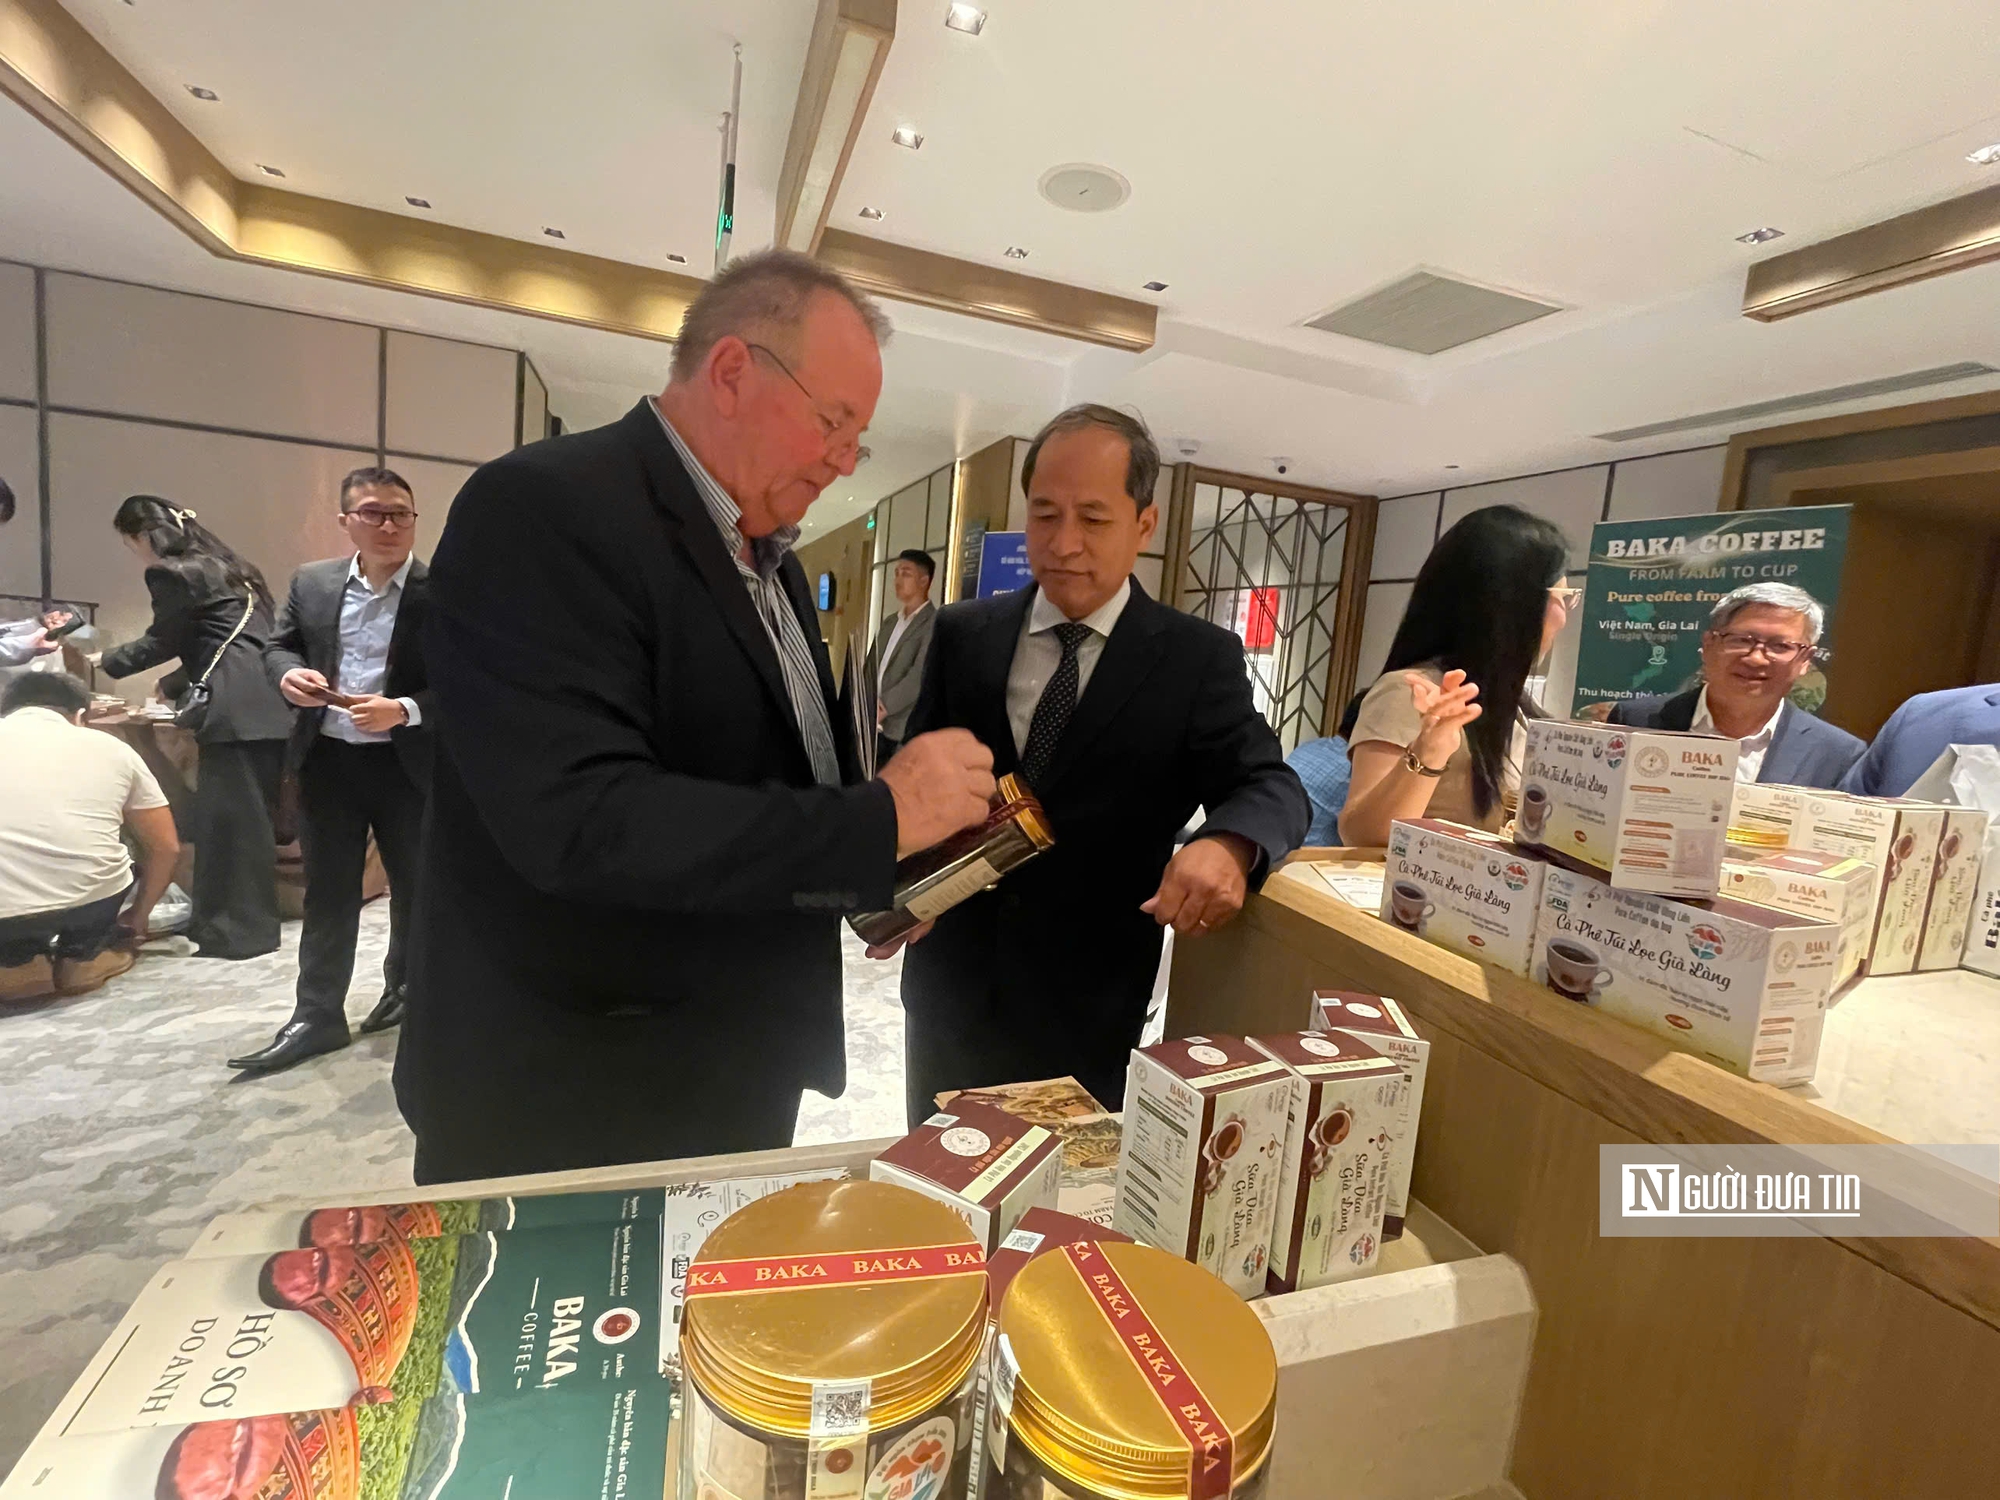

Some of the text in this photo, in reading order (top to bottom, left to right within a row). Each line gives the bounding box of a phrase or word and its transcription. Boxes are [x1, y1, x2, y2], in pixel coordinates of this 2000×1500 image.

[1607, 528, 1826, 557] BAKA COFFEE
[1629, 564, 1798, 581] FROM FARM TO CUP
[1607, 590, 1644, 602] Pure
[1646, 590, 1693, 602] coffee
[1599, 620, 1699, 632] Việt Nam, Gia Lai
[1578, 687, 1598, 696] Thu
[1600, 688, 1633, 700] hoạch
[1682, 751, 1723, 766] BAKA
[1398, 859, 1409, 874] Cà
[1410, 862, 1430, 882] Phê
[1465, 883, 1483, 901] Già
[1483, 889, 1512, 915] Làng
[1788, 882, 1828, 900] BAKA
[1551, 897, 1569, 911] FDA
[1556, 913, 1573, 932] Cà
[1575, 919, 1602, 942] Phê
[1603, 929, 1626, 951] Túi
[1628, 939, 1657, 963] Lọc
[1659, 949, 1687, 973] Già
[1689, 958, 1732, 992] Làng
[1388, 1042, 1417, 1054] BAKA
[678, 1261, 688, 1278] FDA
[689, 1271, 729, 1288] KA
[755, 1263, 828, 1282] BAKA
[853, 1257, 922, 1274] BAKA
[514, 1312, 538, 1375] COFFEE
[543, 1296, 585, 1383] BAKA
[138, 1316, 219, 1416] DOANH
[199, 1311, 276, 1409] HỒ SƠ
[1092, 1272, 1131, 1320] BAKA
[1132, 1333, 1177, 1387] BAKA
[1180, 1402, 1223, 1475] BAKA
[616, 1473, 627, 1492] Gia
